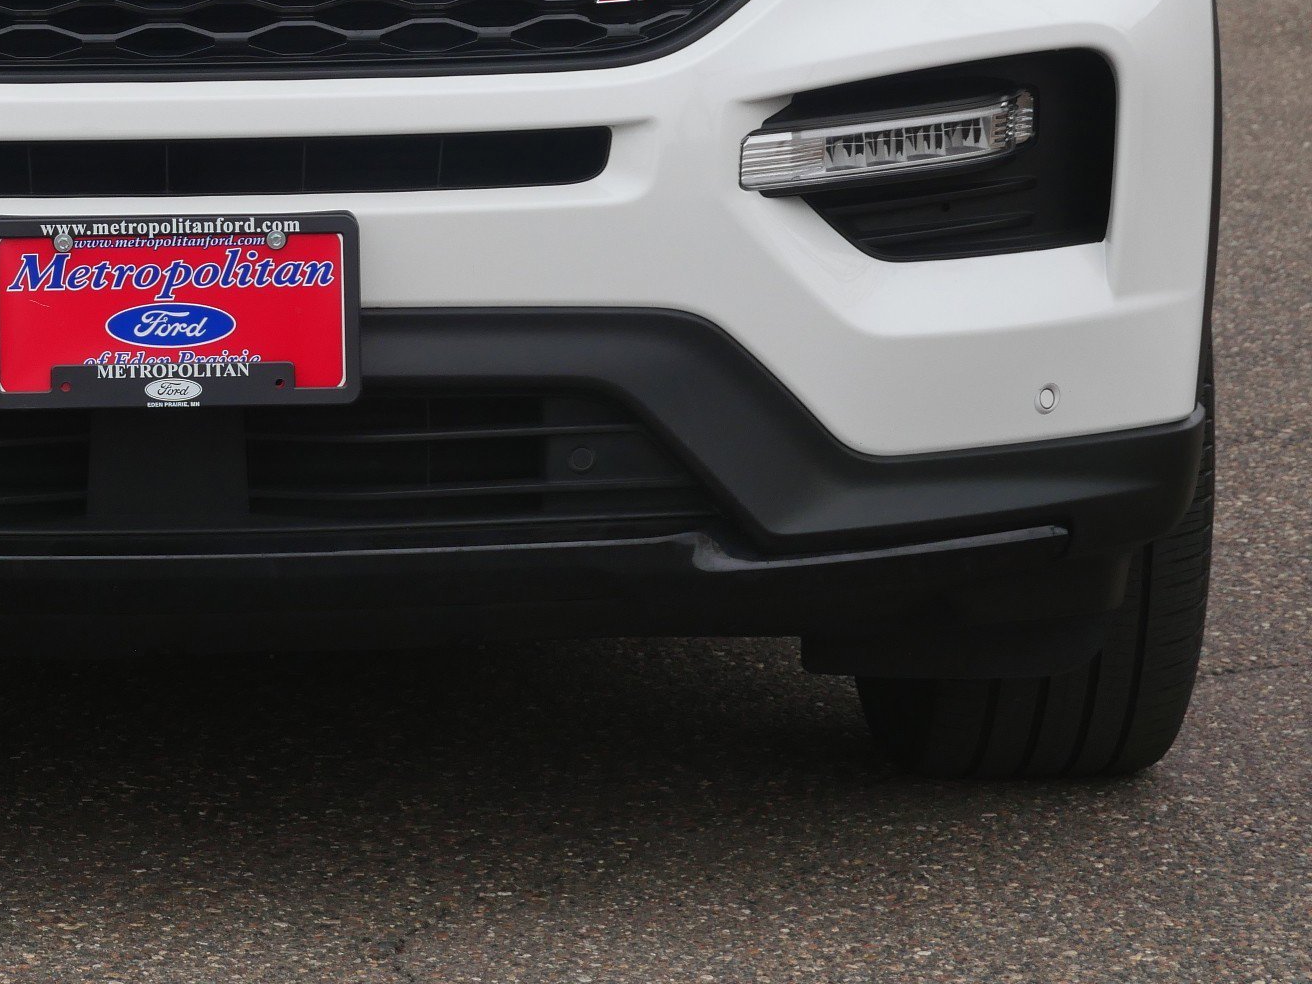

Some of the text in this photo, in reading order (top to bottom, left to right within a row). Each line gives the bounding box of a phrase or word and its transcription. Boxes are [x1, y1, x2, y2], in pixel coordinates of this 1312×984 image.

[40, 217, 301, 239] www.metropolitanford.com
[73, 235, 266, 251] www.metropolitanford.com
[6, 247, 335, 301] Metropolitan
[133, 310, 209, 337] Ford
[97, 362, 250, 379] METROPOLITAN
[157, 382, 190, 396] Ford
